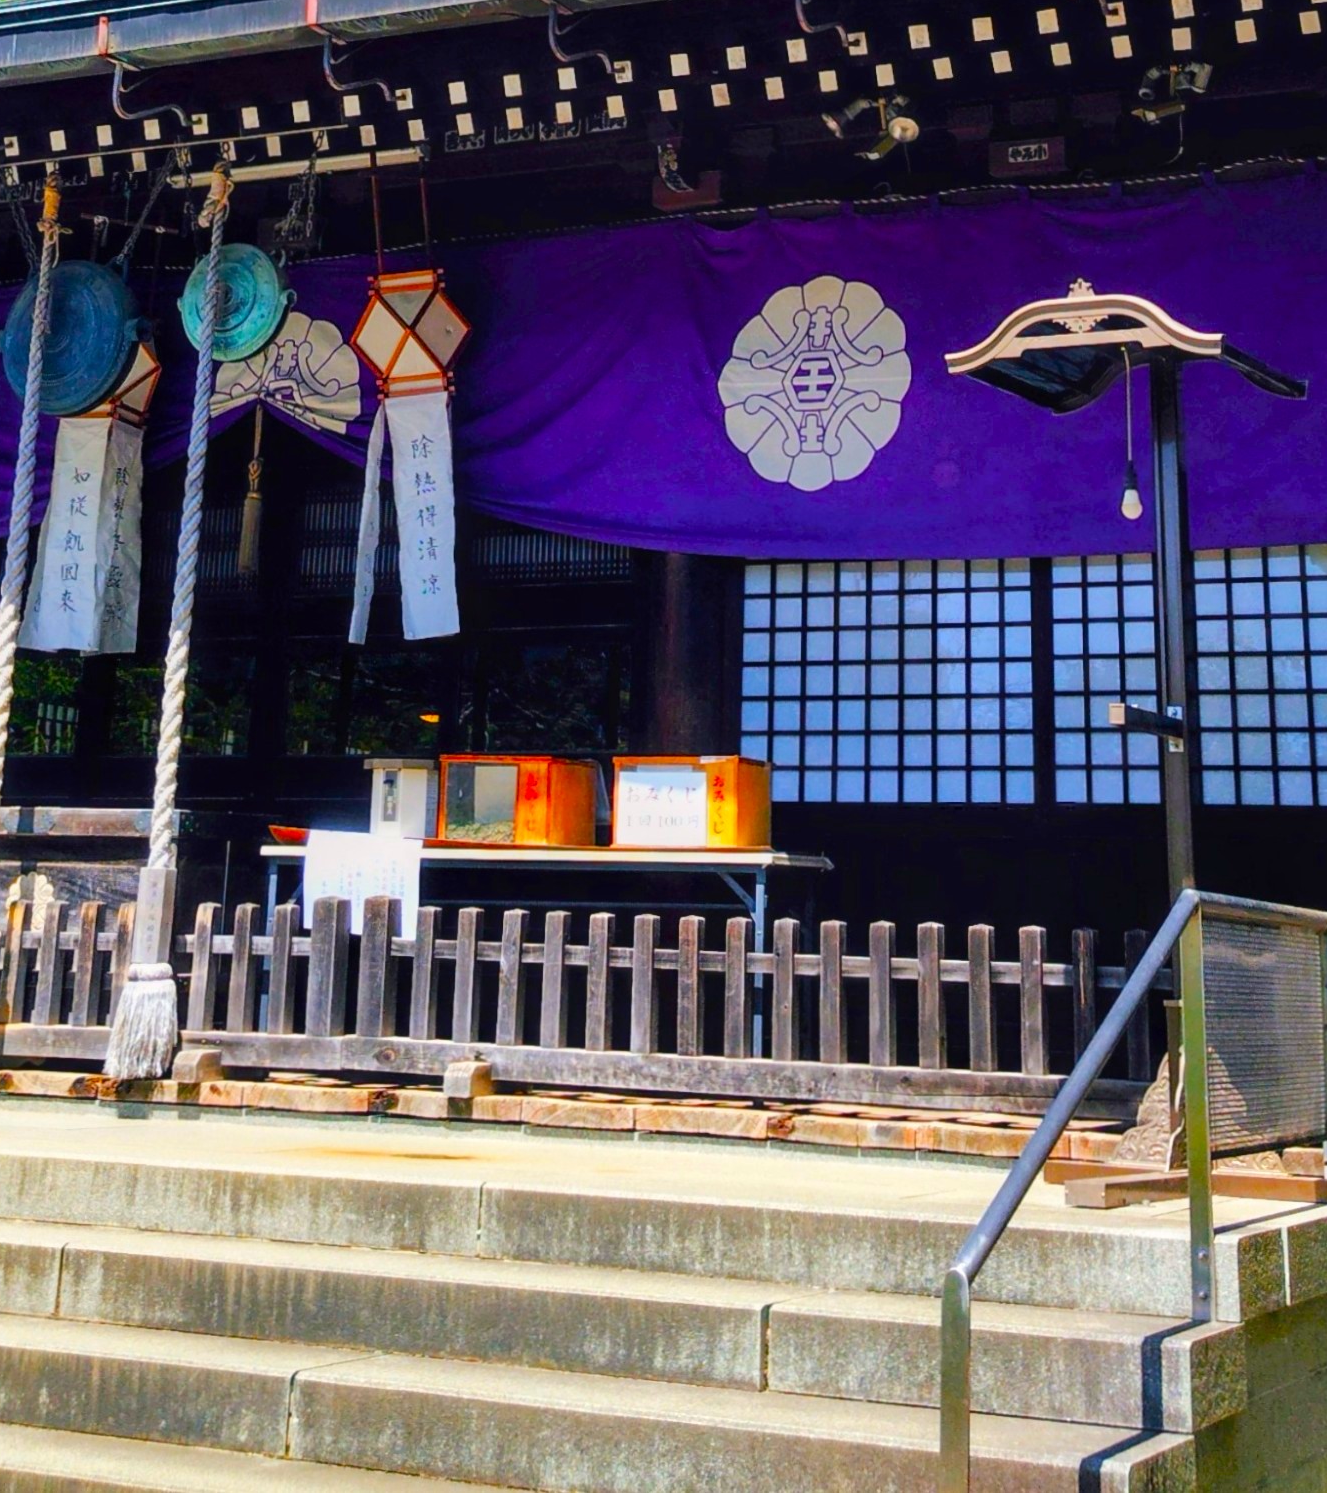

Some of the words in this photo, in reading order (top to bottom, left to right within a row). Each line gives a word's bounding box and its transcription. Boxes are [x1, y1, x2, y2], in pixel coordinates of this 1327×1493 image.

[626, 785, 698, 804] おみくじ
[712, 775, 725, 834] おみくじ
